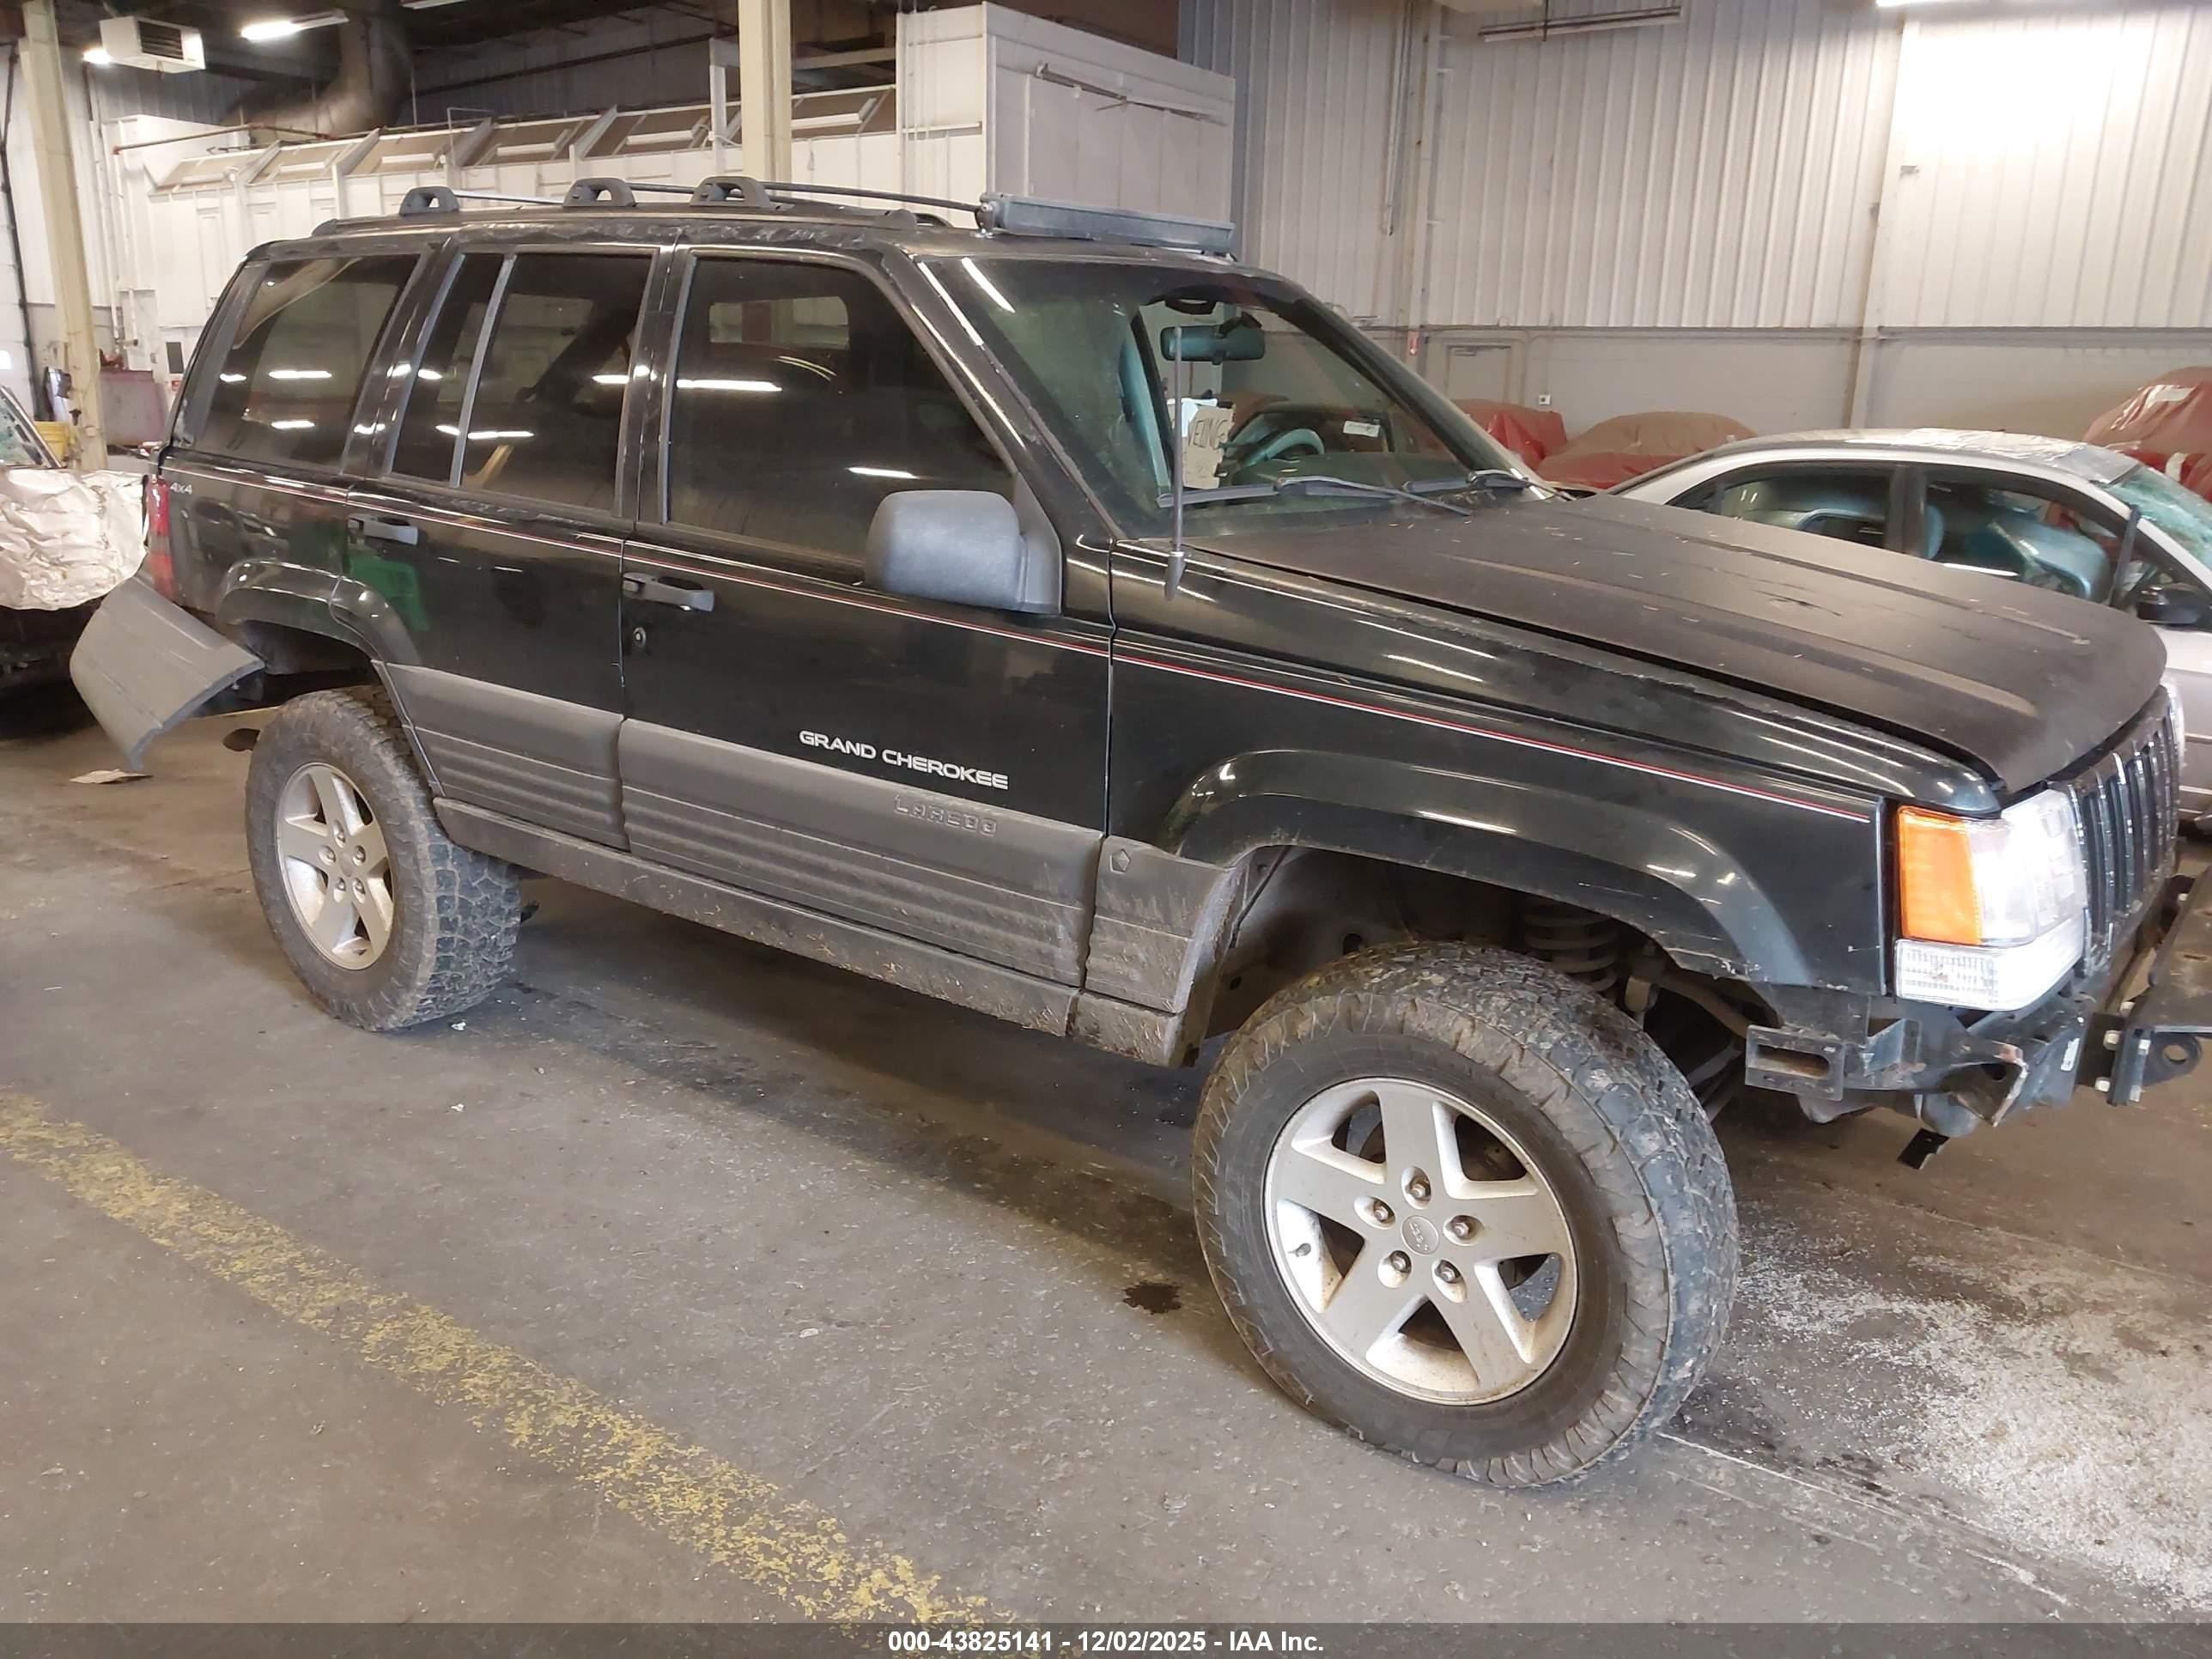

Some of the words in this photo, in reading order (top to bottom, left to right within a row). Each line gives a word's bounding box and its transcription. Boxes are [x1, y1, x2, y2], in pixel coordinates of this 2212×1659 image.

[169, 482, 193, 495] 4x4
[799, 730, 877, 760] GRAND
[881, 749, 1009, 790] CHEROKEE
[894, 794, 997, 837] LAREDO
